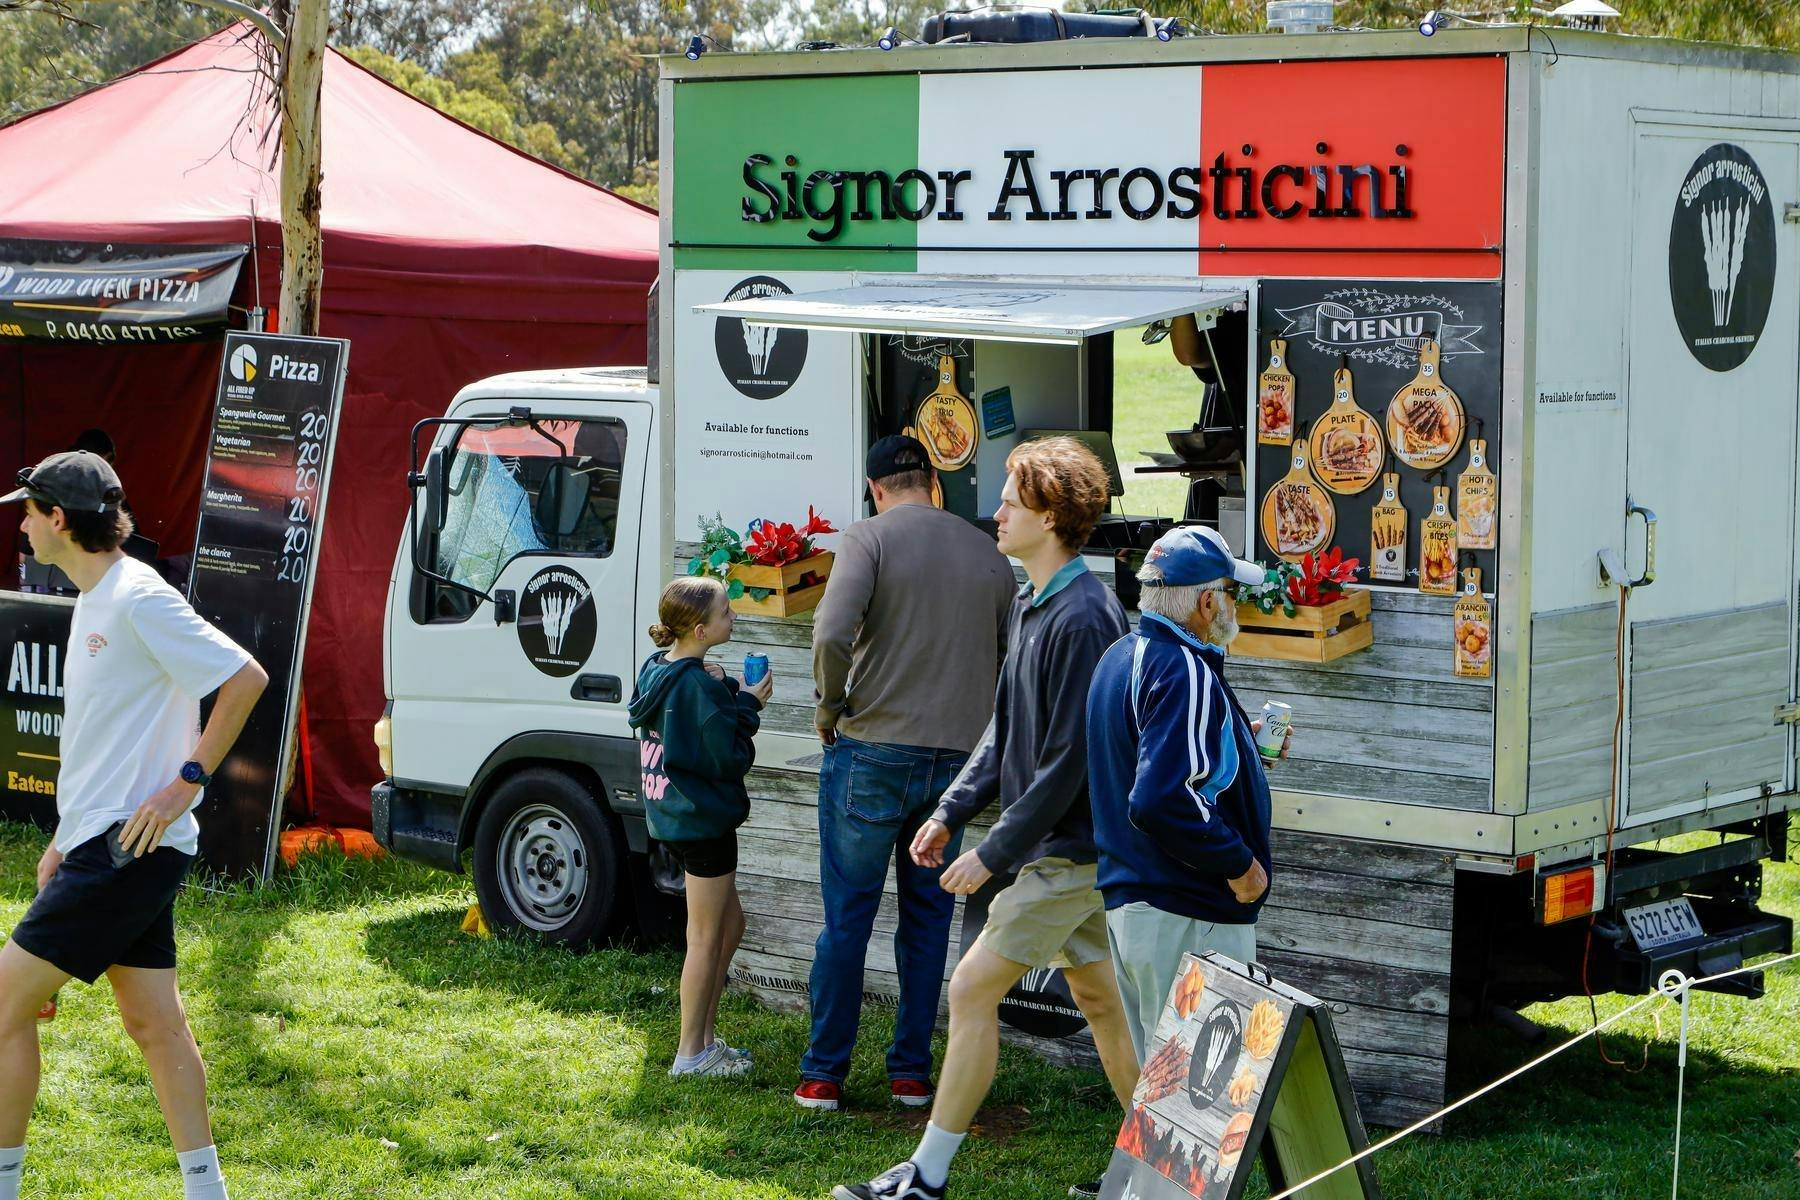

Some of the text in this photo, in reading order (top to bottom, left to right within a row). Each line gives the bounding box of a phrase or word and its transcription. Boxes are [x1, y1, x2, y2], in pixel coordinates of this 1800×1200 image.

[1715, 159, 1765, 205] arrosticini
[742, 143, 1413, 242] Signor Arrosticini
[13, 276, 75, 294] WOOD
[77, 278, 133, 299] OVEN
[138, 278, 200, 303] PIZZA
[726, 285, 751, 302] ignor
[46, 320, 64, 339] P.
[66, 321, 116, 341] 0410
[121, 325, 157, 340] 477
[1331, 316, 1424, 341] MENU
[269, 354, 321, 383] Pizza
[1423, 365, 1433, 373] 35
[1263, 374, 1291, 384] CHICKEN
[1268, 384, 1285, 393] POPS
[1412, 387, 1437, 398] MEGA
[936, 397, 957, 406] TASTY
[1338, 391, 1348, 400] 20
[1539, 390, 1617, 404] Available for functions
[1413, 399, 1436, 409] PACK
[257, 411, 286, 423] Gourmet
[937, 408, 954, 417] TRIO
[301, 412, 328, 440] 20
[1331, 415, 1356, 425] PLATE
[704, 421, 809, 438] Available for functions
[216, 434, 251, 447] Vegetarian
[297, 441, 321, 466] 20
[700, 448, 813, 463] signorarrosticini@hotmail.com
[1474, 456, 1481, 464] 8
[295, 467, 318, 492] 20
[1469, 476, 1484, 485] HOT
[206, 490, 243, 503] Margherita
[1287, 485, 1310, 495] TASTE
[1385, 490, 1394, 499] 15
[1465, 486, 1489, 496] CHIPS
[288, 496, 311, 523] 20
[1382, 508, 1396, 516] BAG
[1436, 505, 1444, 513] 18
[1427, 522, 1453, 531] CRISPY
[283, 525, 308, 554] 20
[199, 546, 232, 559] the clarice
[277, 556, 305, 583] 20
[1466, 584, 1475, 592] 18
[1456, 604, 1489, 613] ARANCINI
[1462, 614, 1483, 622] BALLS
[7, 640, 64, 697] ALL
[16, 709, 63, 737] WOOD
[7, 770, 56, 796] Eaten
[1018, 1000, 1054, 1013] CHARCOAL
